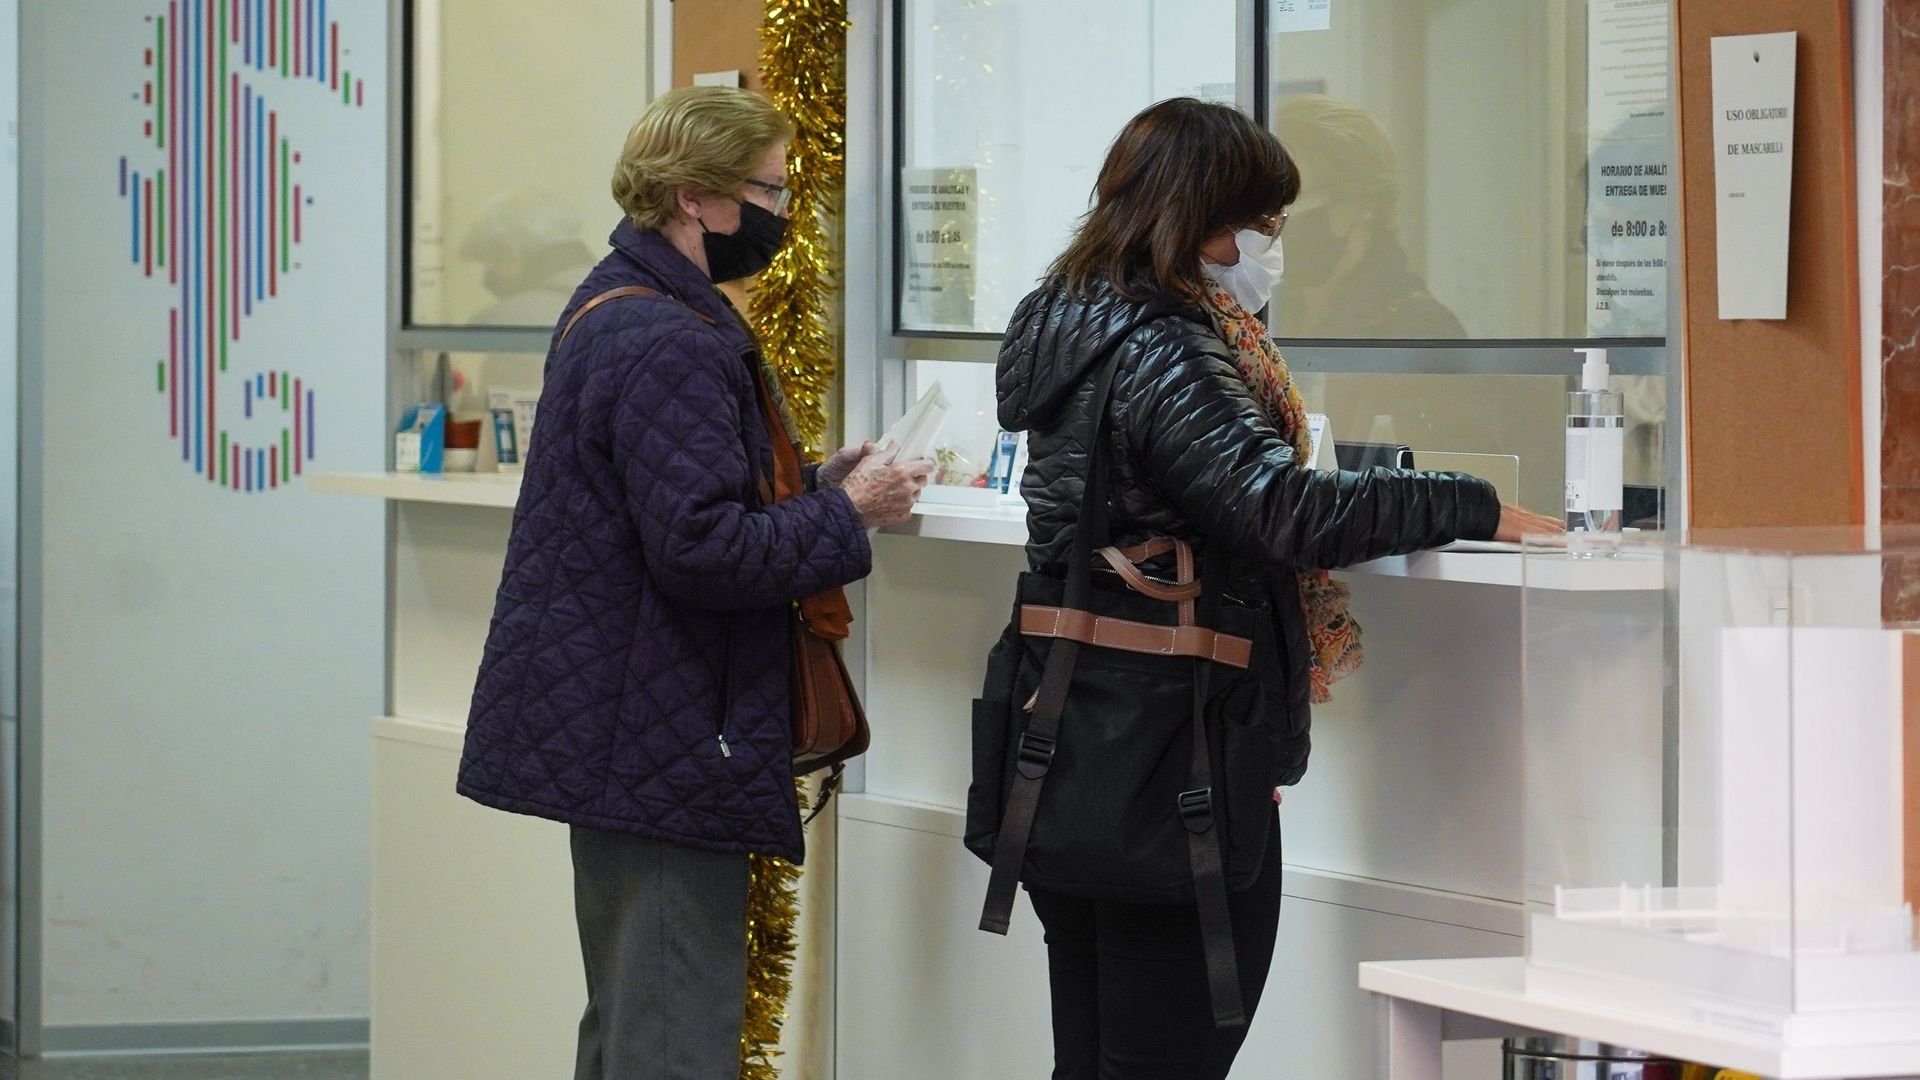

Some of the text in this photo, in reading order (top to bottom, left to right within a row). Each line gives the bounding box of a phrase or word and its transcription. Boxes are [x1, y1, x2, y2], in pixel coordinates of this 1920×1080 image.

[1726, 109, 1744, 121] USO
[1727, 141, 1783, 155] DE MASCARILLA
[1601, 165, 1632, 176] HORARIO
[1633, 165, 1643, 176] DE
[1605, 185, 1637, 196] ENTREGA
[1638, 185, 1648, 196] DE
[1611, 220, 1624, 237] de
[1626, 220, 1647, 237] 8:00
[1649, 224, 1656, 237] a
